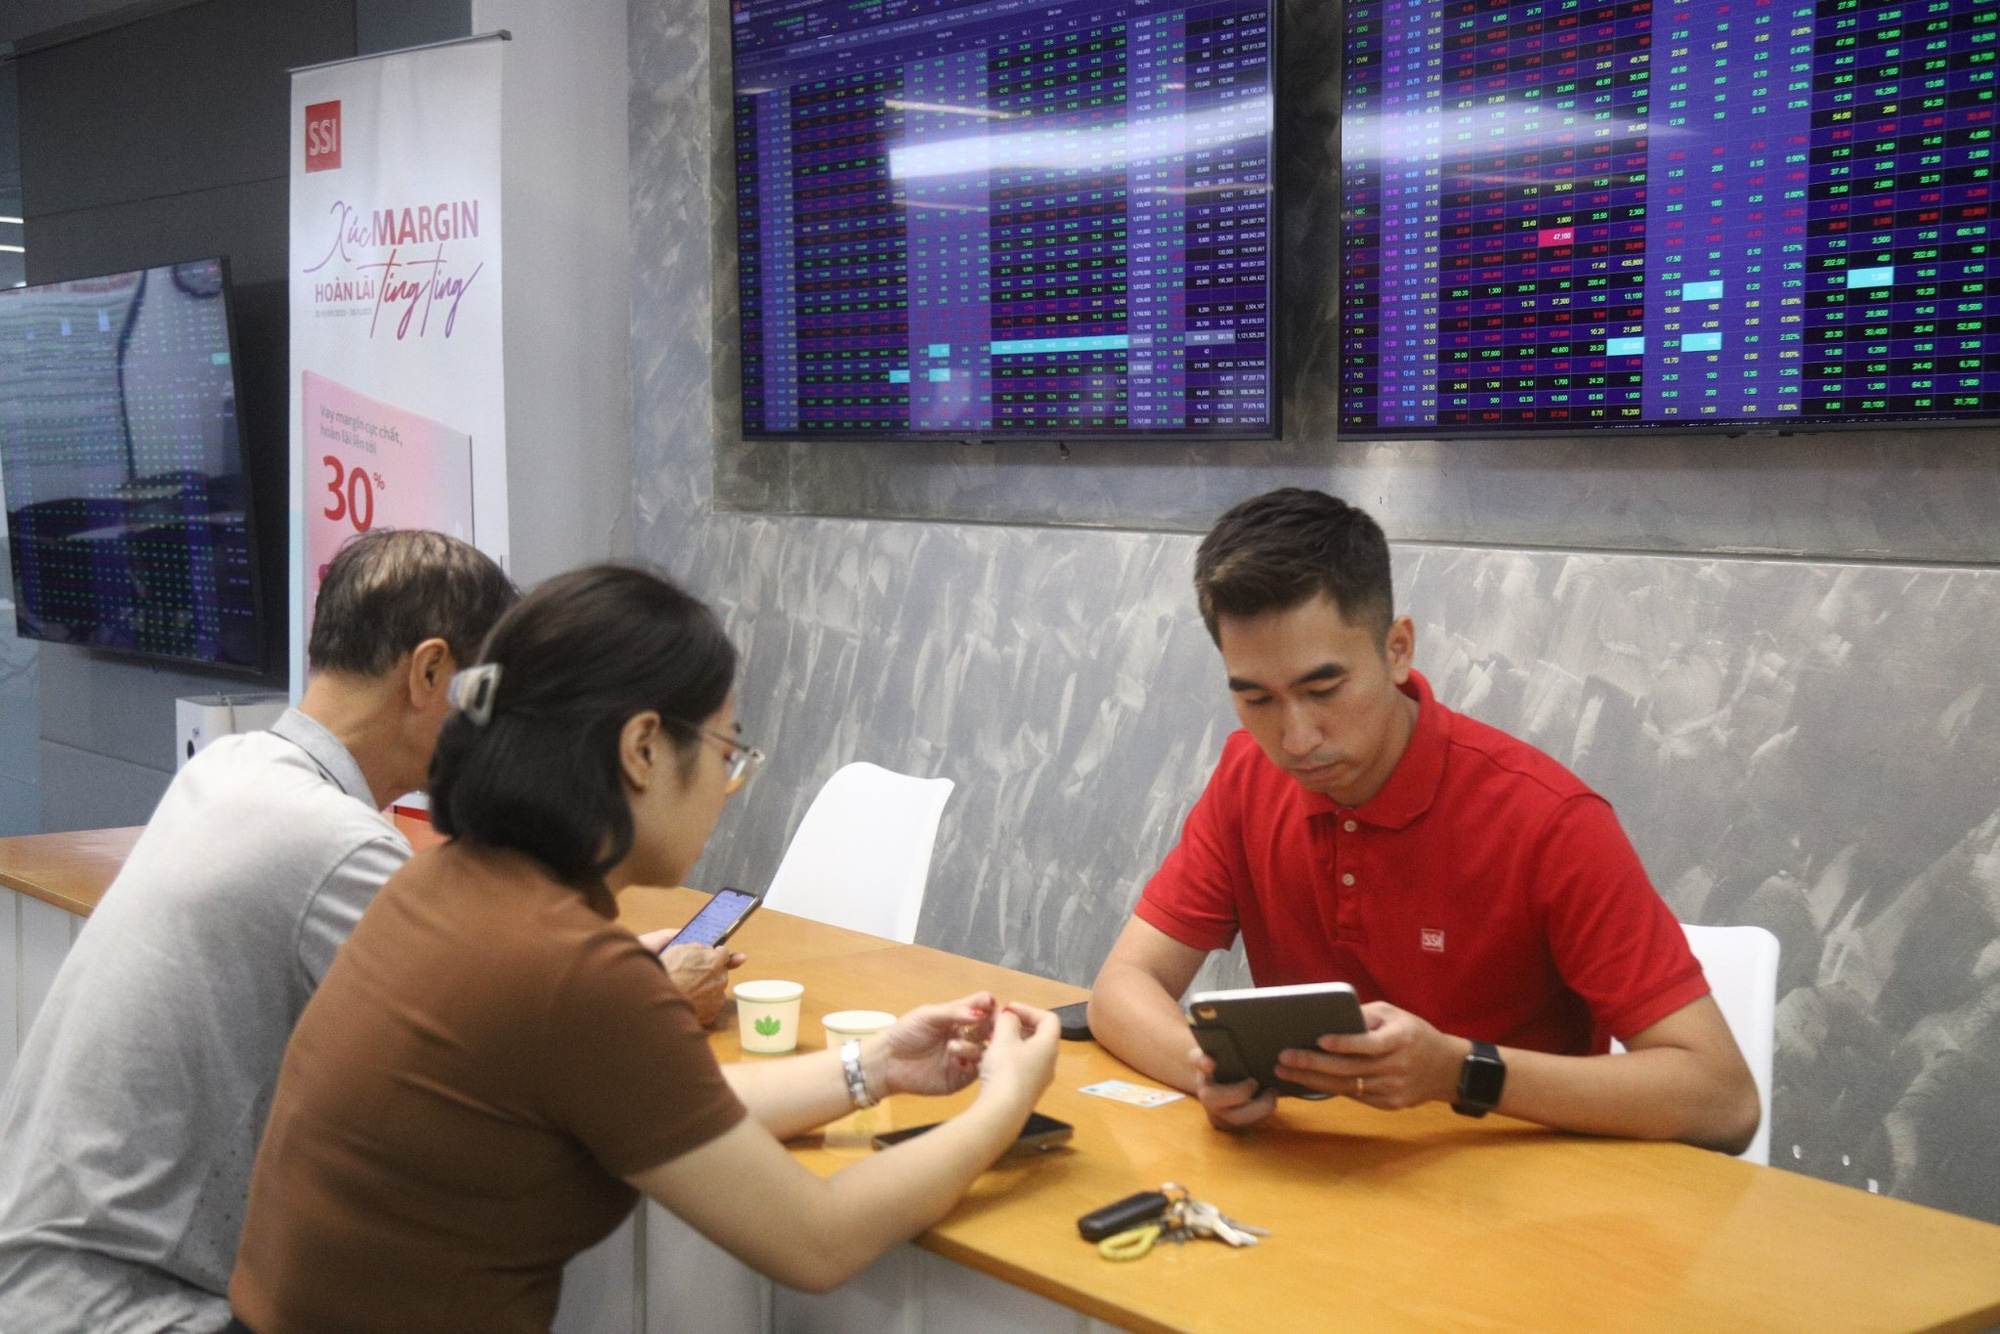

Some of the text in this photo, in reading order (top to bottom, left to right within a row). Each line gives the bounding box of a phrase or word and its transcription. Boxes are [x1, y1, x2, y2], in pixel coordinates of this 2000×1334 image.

[309, 118, 337, 156] SSI
[372, 200, 478, 246] MARGIN
[316, 277, 353, 303] HOÀN
[336, 412, 364, 432] margin
